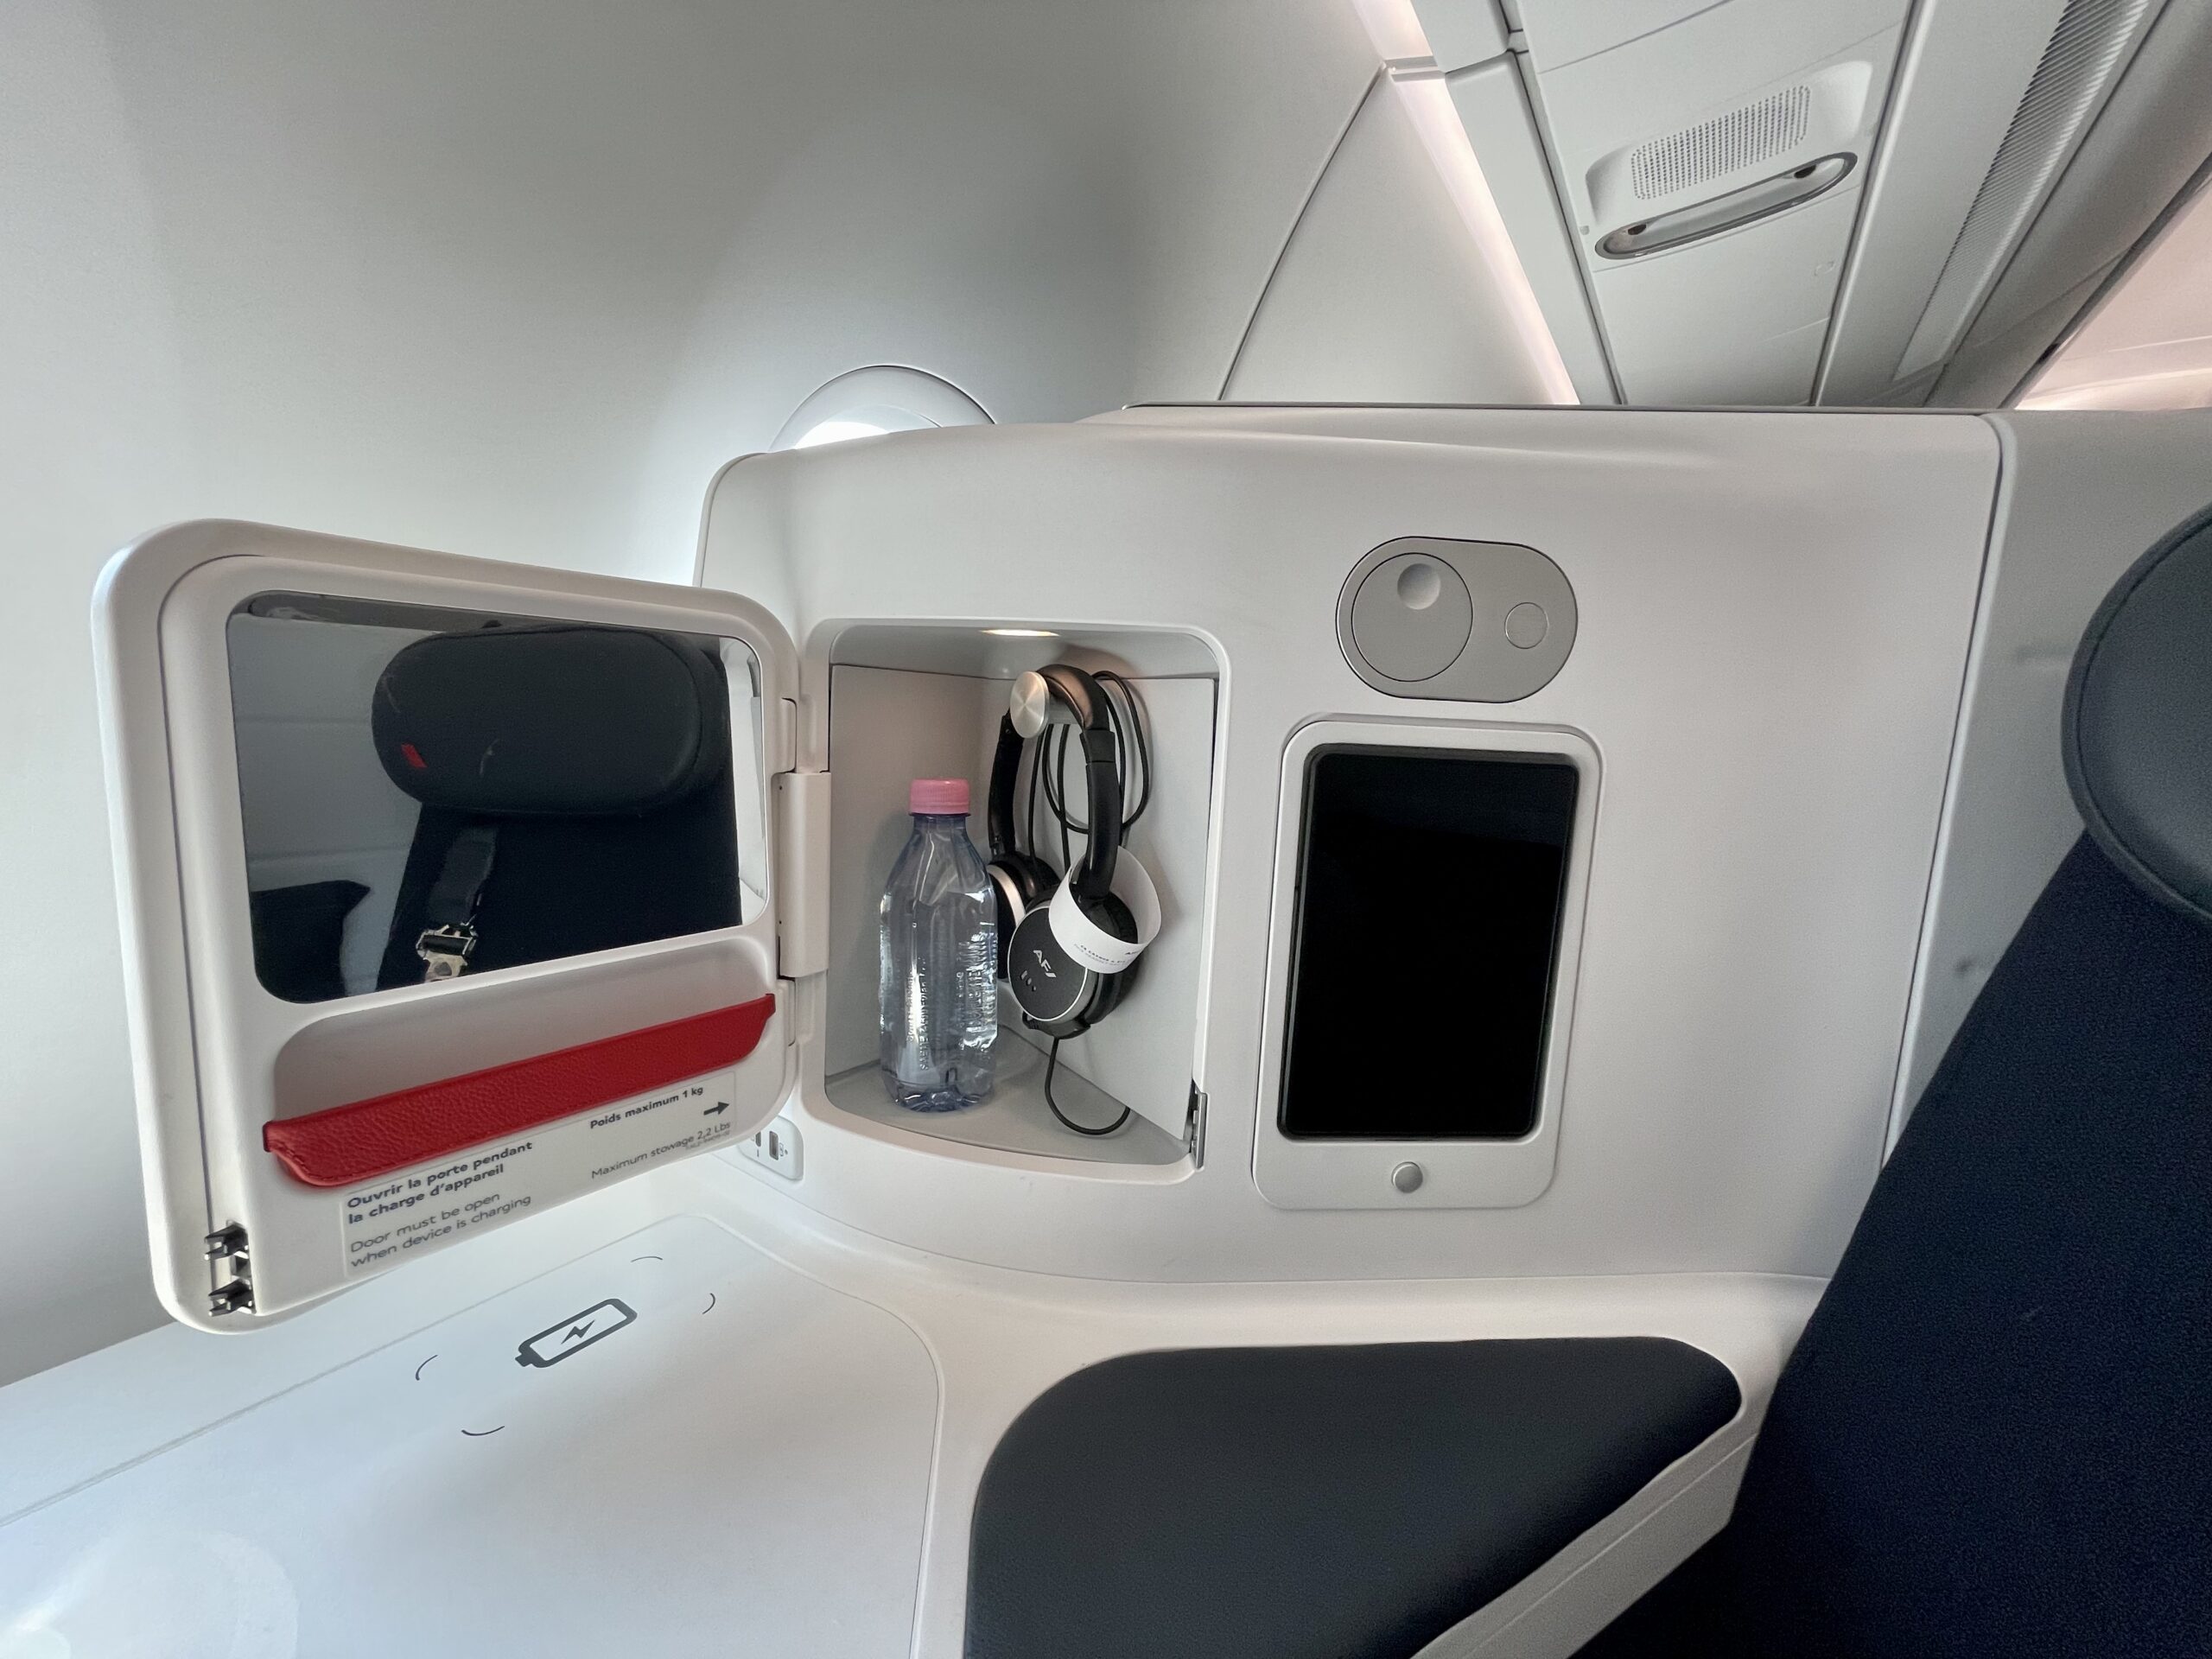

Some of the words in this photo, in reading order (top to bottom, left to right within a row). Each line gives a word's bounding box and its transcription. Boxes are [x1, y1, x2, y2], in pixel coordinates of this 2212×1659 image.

[590, 1113, 621, 1129] Poids
[625, 1095, 679, 1118] maximum
[682, 1090, 689, 1098] 1
[691, 1087, 703, 1096] kg
[347, 1185, 403, 1208] Ouvrir
[408, 1179, 422, 1189] la
[427, 1164, 468, 1185] porte
[473, 1141, 533, 1171] pendant
[591, 1153, 647, 1179] Maximum
[650, 1136, 694, 1157] stowage
[697, 1128, 712, 1140] 2,2
[714, 1122, 730, 1133] Lbs
[348, 1213, 363, 1224] la
[369, 1192, 425, 1217] charge
[351, 1231, 391, 1253] Door
[397, 1216, 436, 1236] must
[442, 1207, 460, 1221] be
[464, 1193, 500, 1215] open
[351, 1244, 397, 1267] when
[403, 1225, 452, 1249] device
[456, 1219, 467, 1229] is
[471, 1195, 531, 1224] charging
